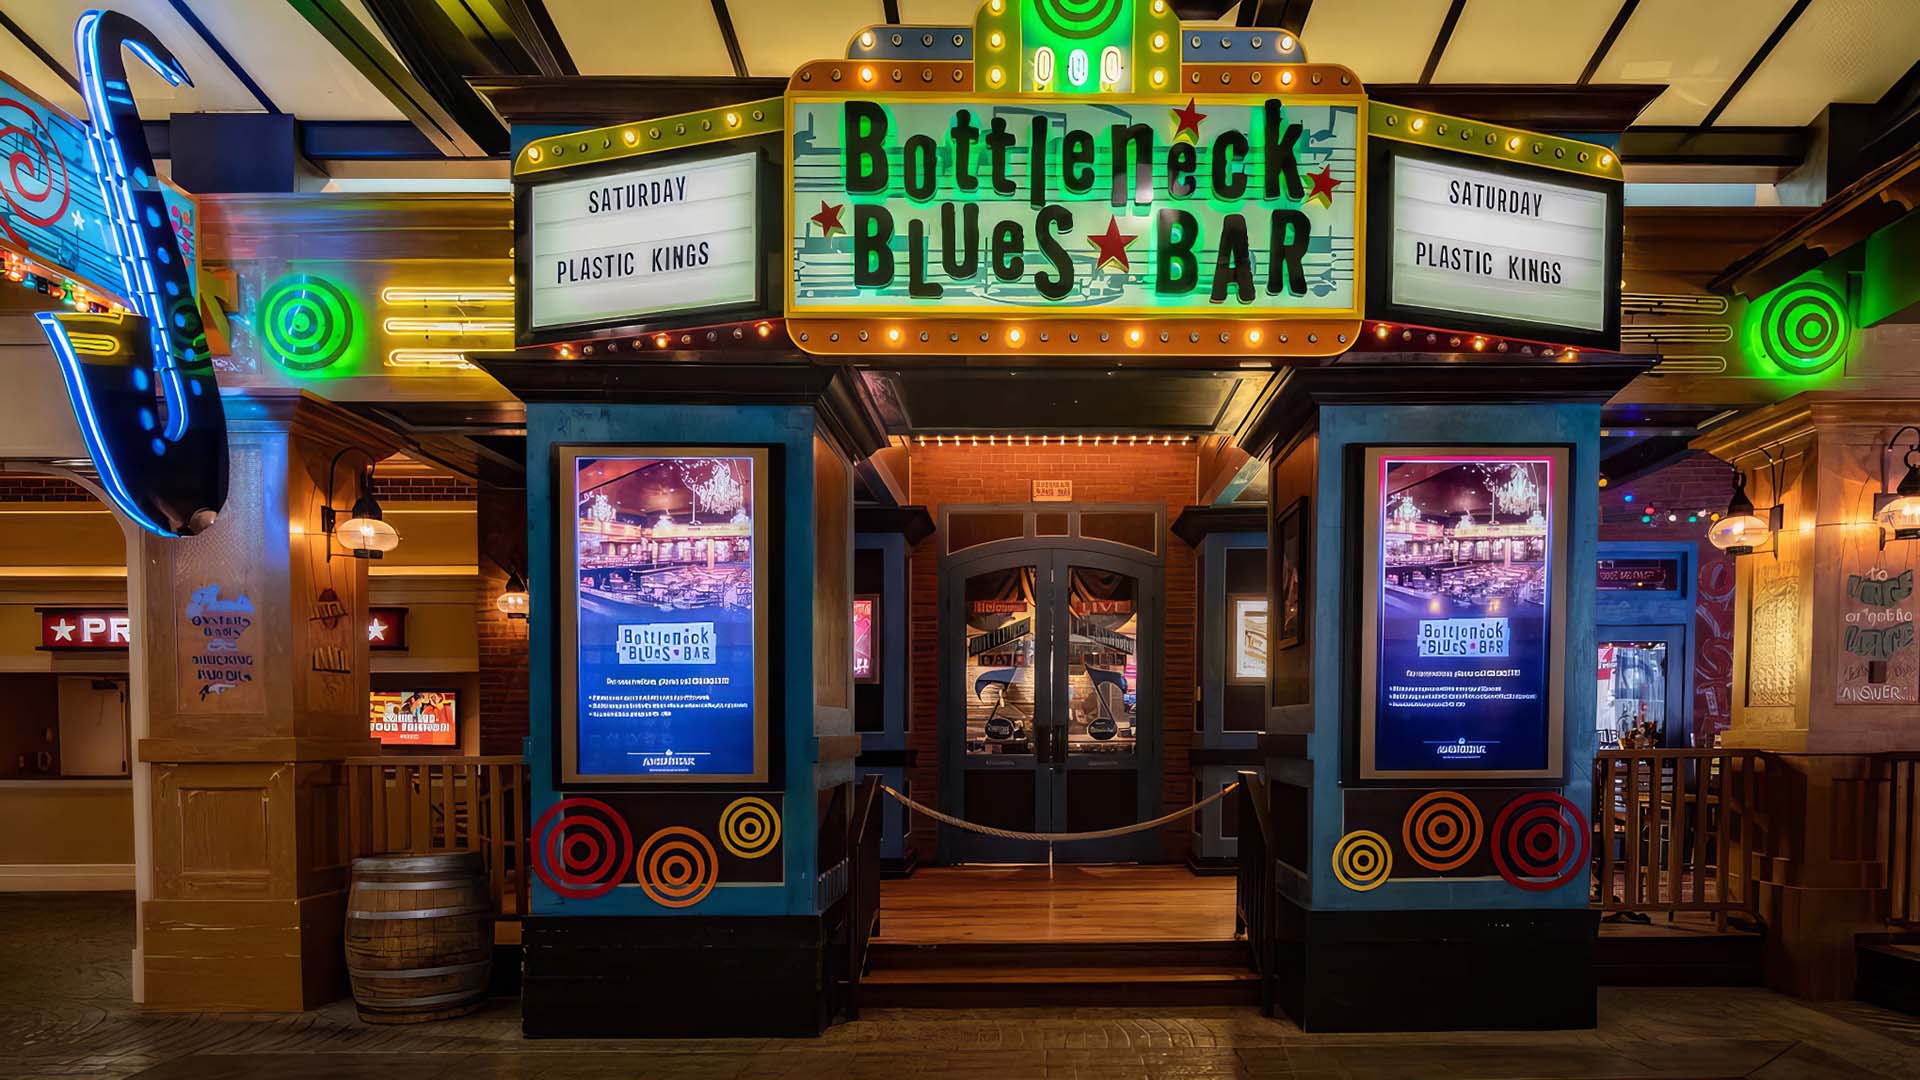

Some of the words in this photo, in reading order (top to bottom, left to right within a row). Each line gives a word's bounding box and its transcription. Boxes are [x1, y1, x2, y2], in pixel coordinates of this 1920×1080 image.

[844, 99, 1305, 209] Bottleneck
[588, 176, 686, 213] SATURDAY
[1450, 180, 1542, 217] SATURDAY
[557, 252, 634, 284] PLASTIC
[652, 241, 709, 272] KINGS
[1156, 208, 1312, 304] BAR
[1416, 242, 1492, 275] PLASTIC
[1509, 255, 1561, 284] KINGS
